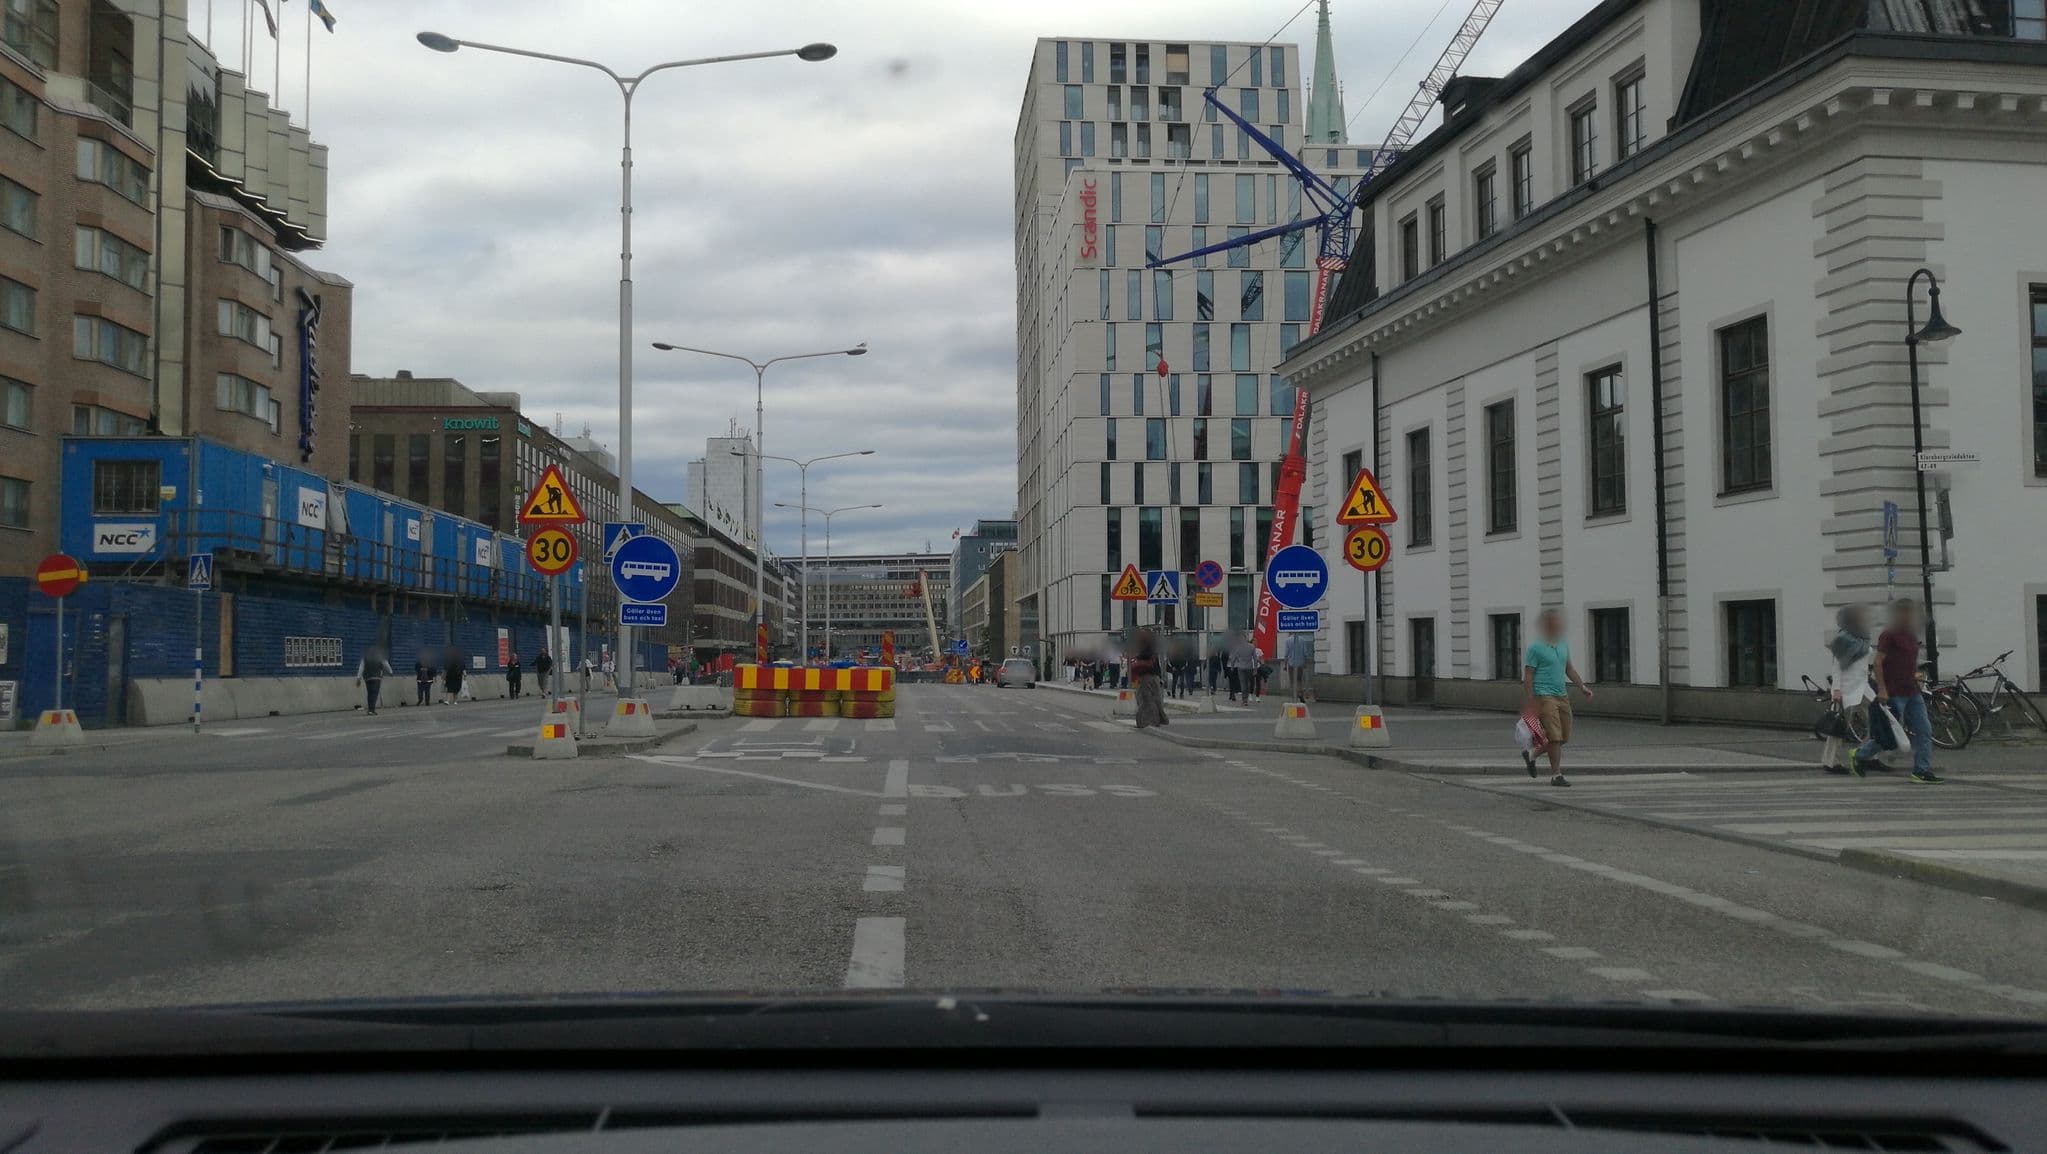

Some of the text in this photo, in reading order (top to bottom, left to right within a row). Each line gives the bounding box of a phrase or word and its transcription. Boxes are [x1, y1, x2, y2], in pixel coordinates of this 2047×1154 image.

[1080, 178, 1097, 258] Scandic
[443, 417, 500, 430] knowit
[301, 501, 320, 519] NCC
[100, 534, 139, 546] NCC
[1353, 536, 1383, 559] 30
[536, 538, 570, 562] 30
[908, 784, 1158, 797] BUSS
